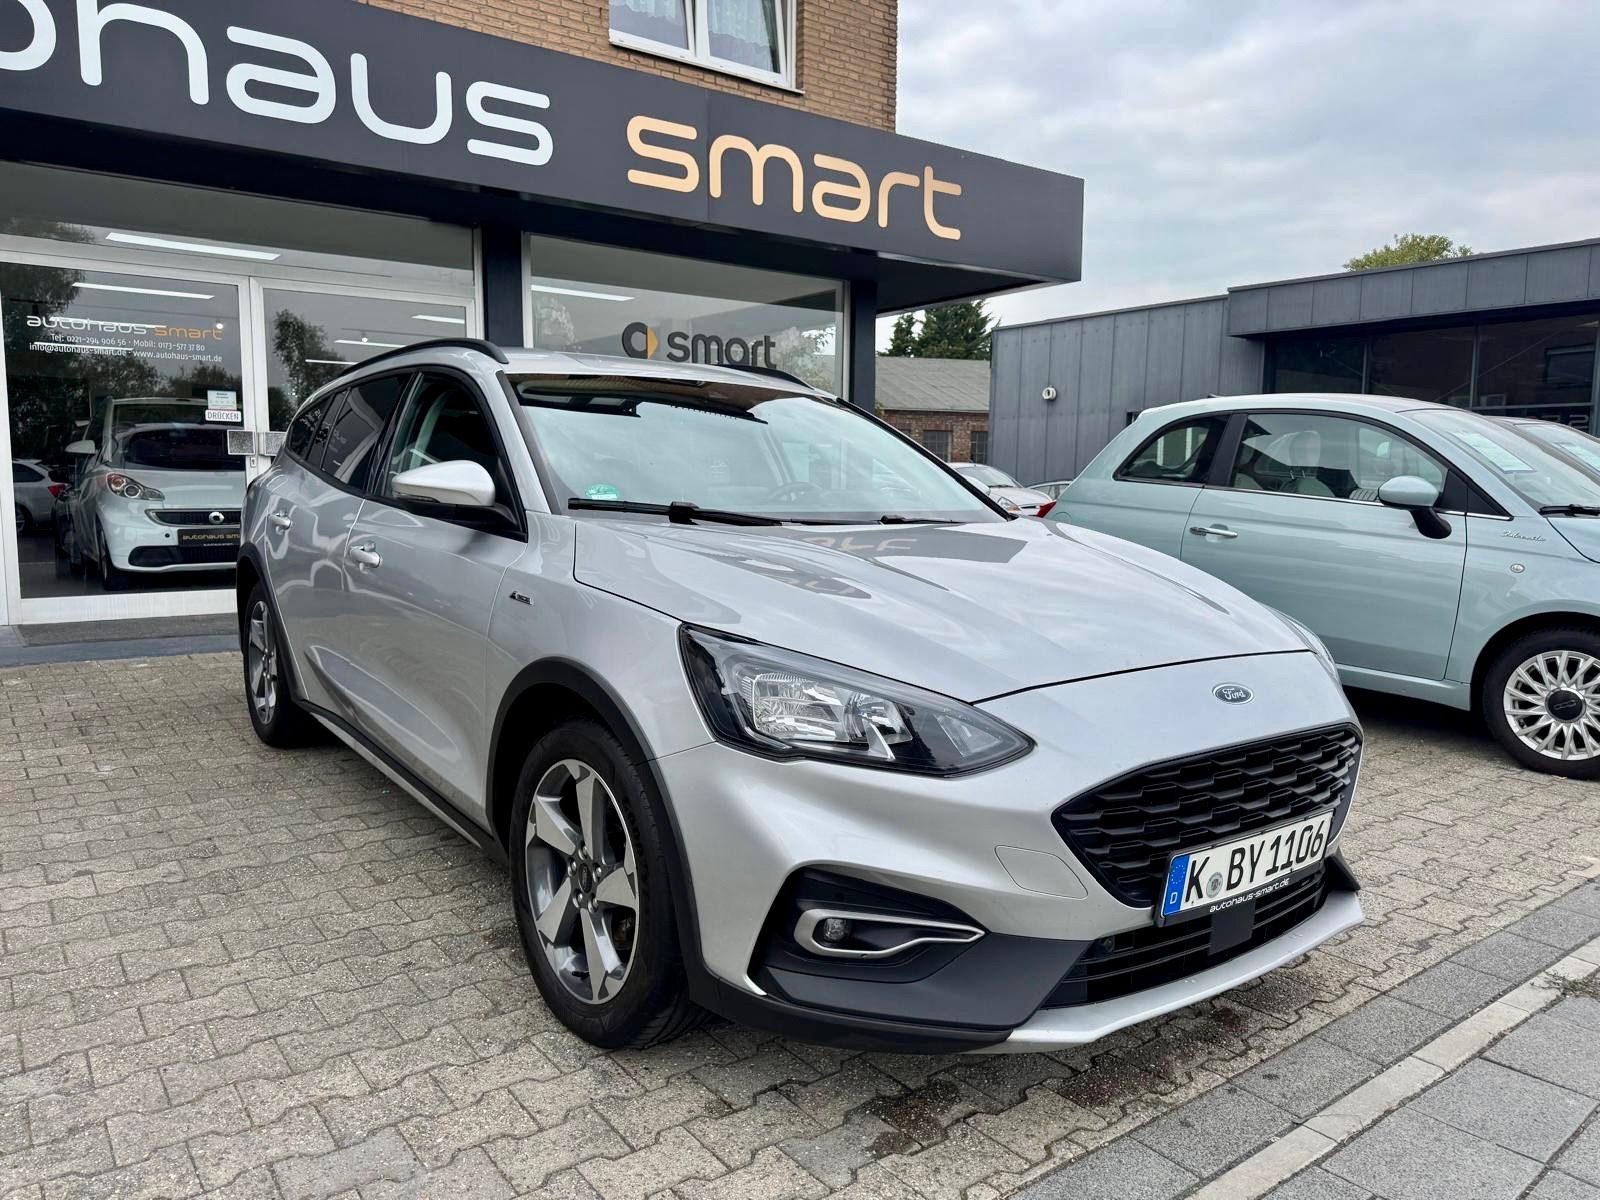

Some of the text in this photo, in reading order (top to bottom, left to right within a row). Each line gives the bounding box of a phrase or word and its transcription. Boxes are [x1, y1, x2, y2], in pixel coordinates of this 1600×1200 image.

[626, 115, 962, 241] smart
[26, 315, 223, 340] autohaus smart
[51, 333, 65, 343] Tel:
[133, 339, 156, 348] Mobil:
[666, 331, 777, 370] smart
[133, 350, 223, 362] www.autohaus-smart.de
[1222, 686, 1246, 701] Ford
[1185, 856, 1211, 904] K
[1169, 891, 1178, 905] D
[1209, 877, 1291, 913] autohaus-smart.de
